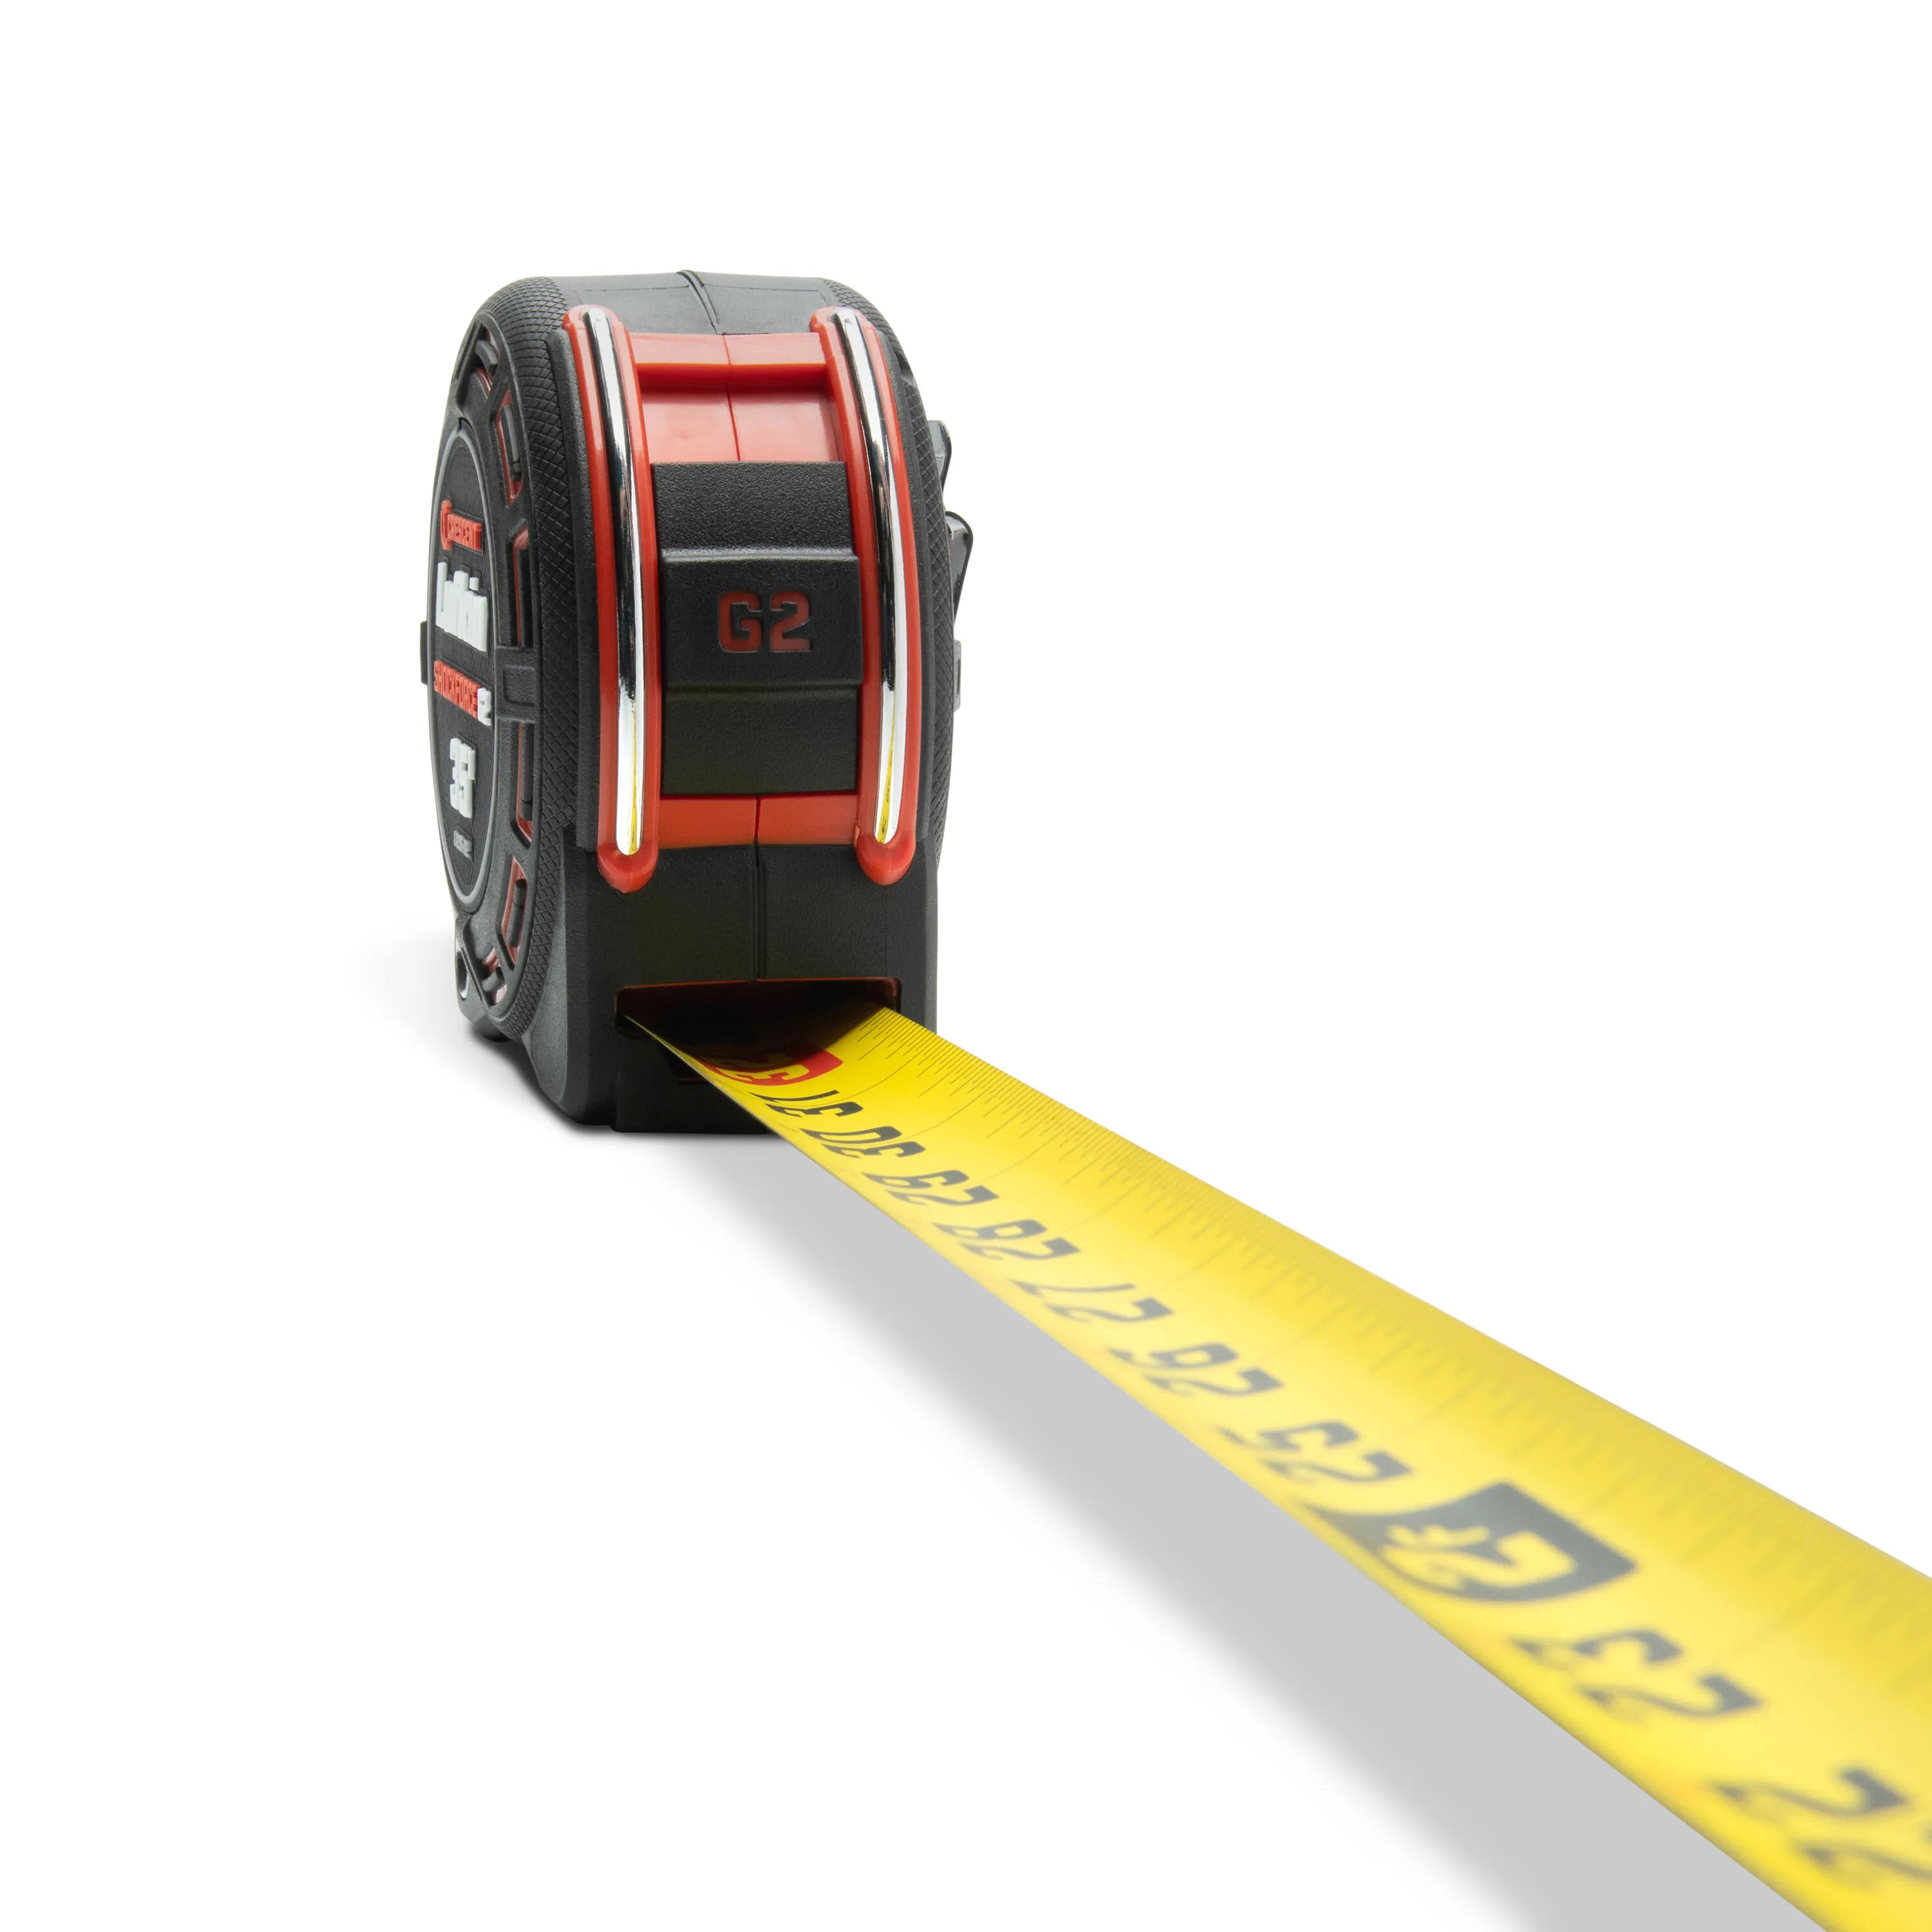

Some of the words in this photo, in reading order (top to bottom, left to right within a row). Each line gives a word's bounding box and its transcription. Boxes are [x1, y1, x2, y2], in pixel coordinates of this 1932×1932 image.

[718, 590, 812, 652] G2
[702, 1054, 810, 1083] 3
[748, 1090, 863, 1118] 31
[799, 1126, 926, 1159] 30
[861, 1170, 1000, 1206] 29
[931, 1218, 1081, 1260] 28
[1009, 1279, 1174, 1323] 27
[1104, 1342, 1285, 1397] 26
[1216, 1421, 1414, 1483] 25
[1379, 1524, 1578, 1591] 24
[1508, 1627, 1766, 1721] 23
